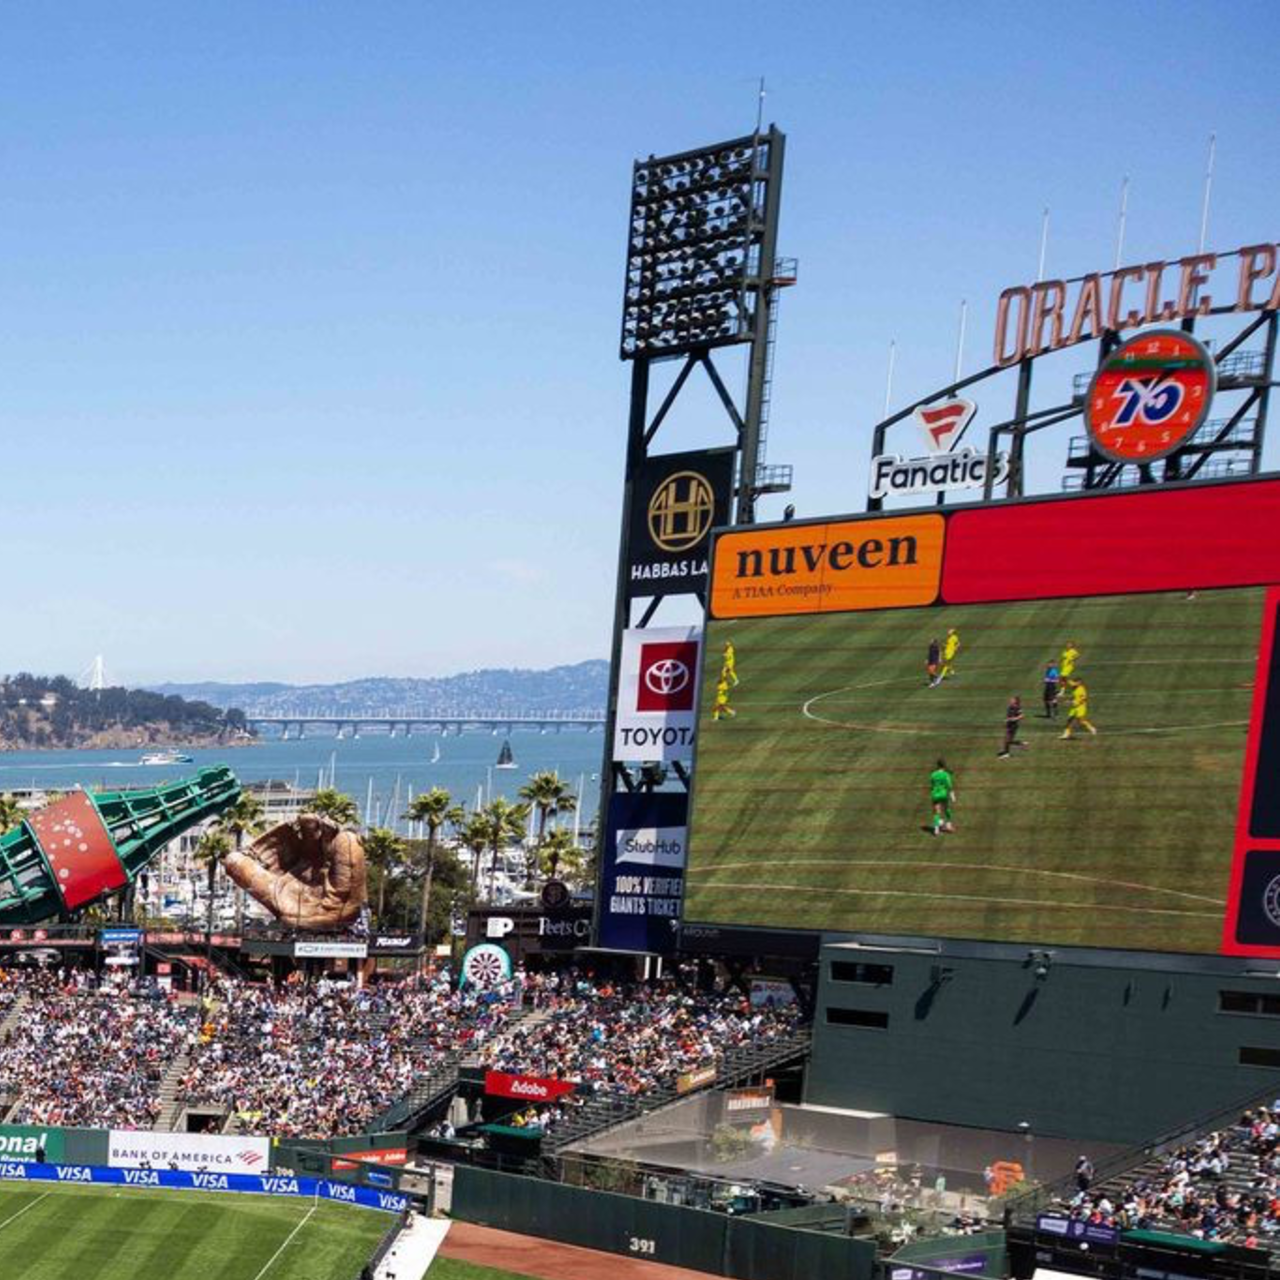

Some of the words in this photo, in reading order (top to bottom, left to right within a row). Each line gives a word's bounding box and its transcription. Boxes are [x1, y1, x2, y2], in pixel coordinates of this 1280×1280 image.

[993, 253, 1217, 368] ORACLE
[735, 535, 918, 578] nuveen
[630, 561, 689, 580] HABBAS
[744, 585, 774, 598] TIAA
[777, 583, 835, 599] Company
[624, 837, 682, 855] StubHub
[610, 897, 646, 915] GIANTS
[510, 1079, 548, 1097] Adobe
[112, 1148, 148, 1160] BANK
[151, 1151, 168, 1161] OF
[171, 1152, 233, 1164] AMERICA
[56, 1166, 92, 1181] VISA
[122, 1169, 160, 1185] VISA
[192, 1173, 229, 1189] VISA
[261, 1177, 300, 1193] VISA
[327, 1182, 356, 1201] VISA
[378, 1193, 407, 1211] VISA
[629, 1237, 657, 1254] 391
